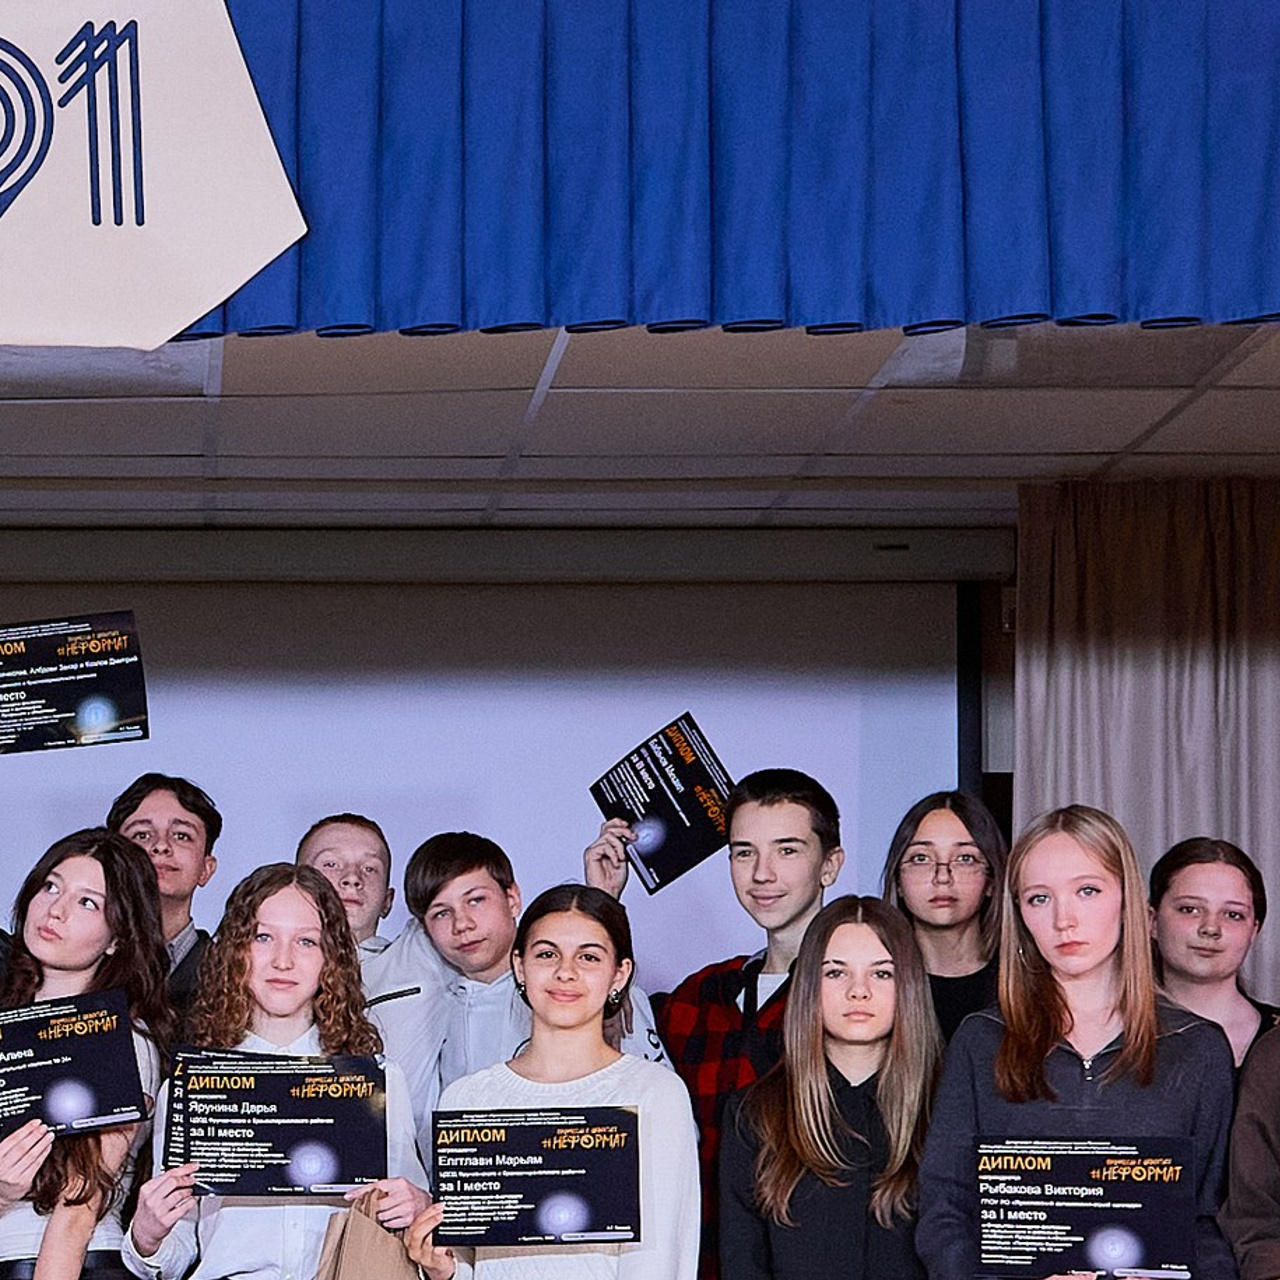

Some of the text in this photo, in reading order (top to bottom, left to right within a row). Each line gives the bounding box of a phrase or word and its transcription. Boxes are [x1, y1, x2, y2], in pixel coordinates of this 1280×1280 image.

[665, 725, 697, 765] ДИПЛОМ
[37, 1015, 118, 1041] #НЕФОРМАТ
[188, 1077, 256, 1092] ДИПЛОМ
[290, 1082, 375, 1100] #НЕФОРМАТ
[241, 1102, 277, 1114] Дарья
[190, 1127, 254, 1138] за II место
[437, 1129, 506, 1145] ДИПЛОМ
[541, 1133, 627, 1149] #НЕФОРМАТ
[495, 1154, 543, 1167] Марьям
[978, 1156, 1051, 1171] ДИПЛОМ
[1089, 1166, 1183, 1183] #НЕФОРМАТ
[439, 1182, 454, 1191] за
[464, 1182, 501, 1191] место
[979, 1183, 1104, 1198] Рыбакова Виктория
[981, 1210, 997, 1220] за
[1007, 1211, 1047, 1221] место
